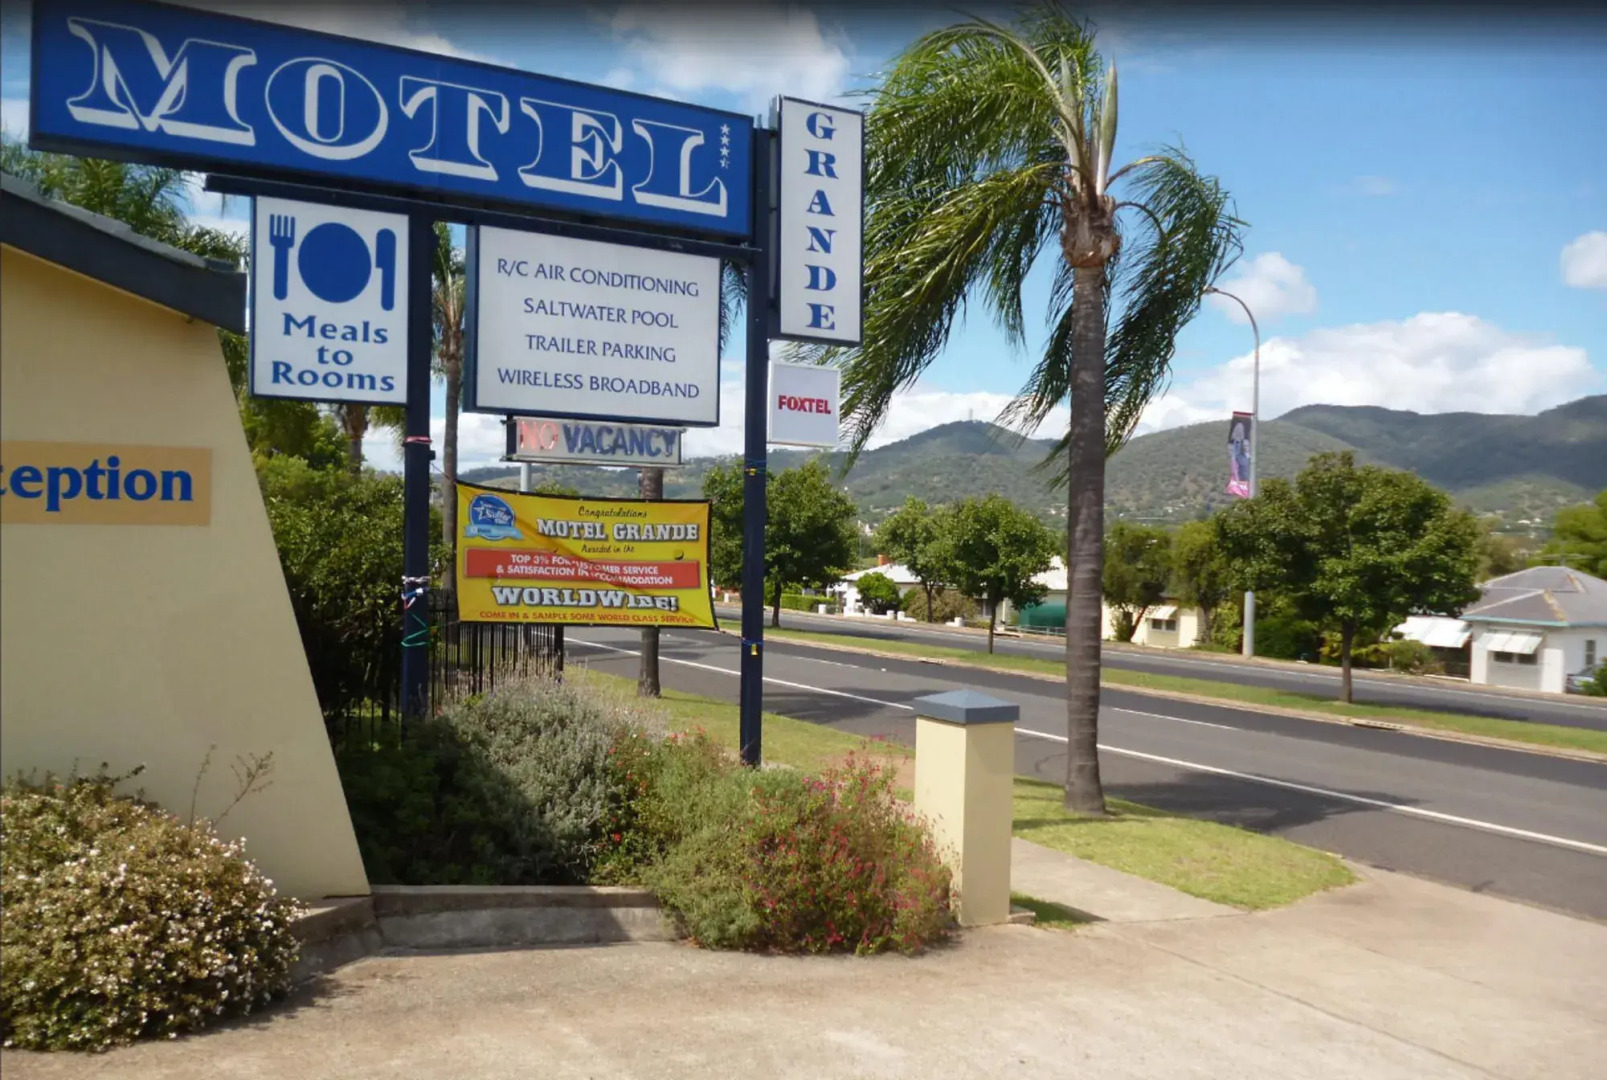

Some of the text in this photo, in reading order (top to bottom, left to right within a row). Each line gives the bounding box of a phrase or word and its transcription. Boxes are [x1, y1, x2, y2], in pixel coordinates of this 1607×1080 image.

[66, 16, 728, 218] MOTEL
[803, 112, 839, 330] GRANDE
[497, 258, 699, 297] R/C AIR CONDITIONING
[523, 298, 678, 329] SALTWATER POOL
[282, 312, 389, 345] Meals
[316, 345, 354, 367] to
[525, 334, 676, 363] TRAILER PARKING
[271, 360, 396, 392] Rooms
[497, 368, 699, 399] WIRELESS BROADBAND
[778, 394, 831, 415] FOXTEL
[520, 420, 677, 457] NO VACANCY
[0, 455, 194, 512] eption
[578, 505, 647, 519] Congratulations
[536, 518, 699, 542] MOTEL GRANDE
[623, 544, 635, 553] the
[496, 564, 504, 574] &
[507, 564, 575, 577] SATISFACTION
[510, 553, 531, 564] TOP
[533, 555, 549, 565] 3%
[622, 565, 659, 575] SERVICE
[490, 585, 679, 612] WORLDWIDE!
[480, 610, 506, 619] COME
[509, 611, 520, 619] IN
[531, 612, 567, 620] SAMPLE
[569, 612, 596, 621] SOME
[598, 613, 630, 621] WORLD
[632, 614, 658, 622] CLASS
